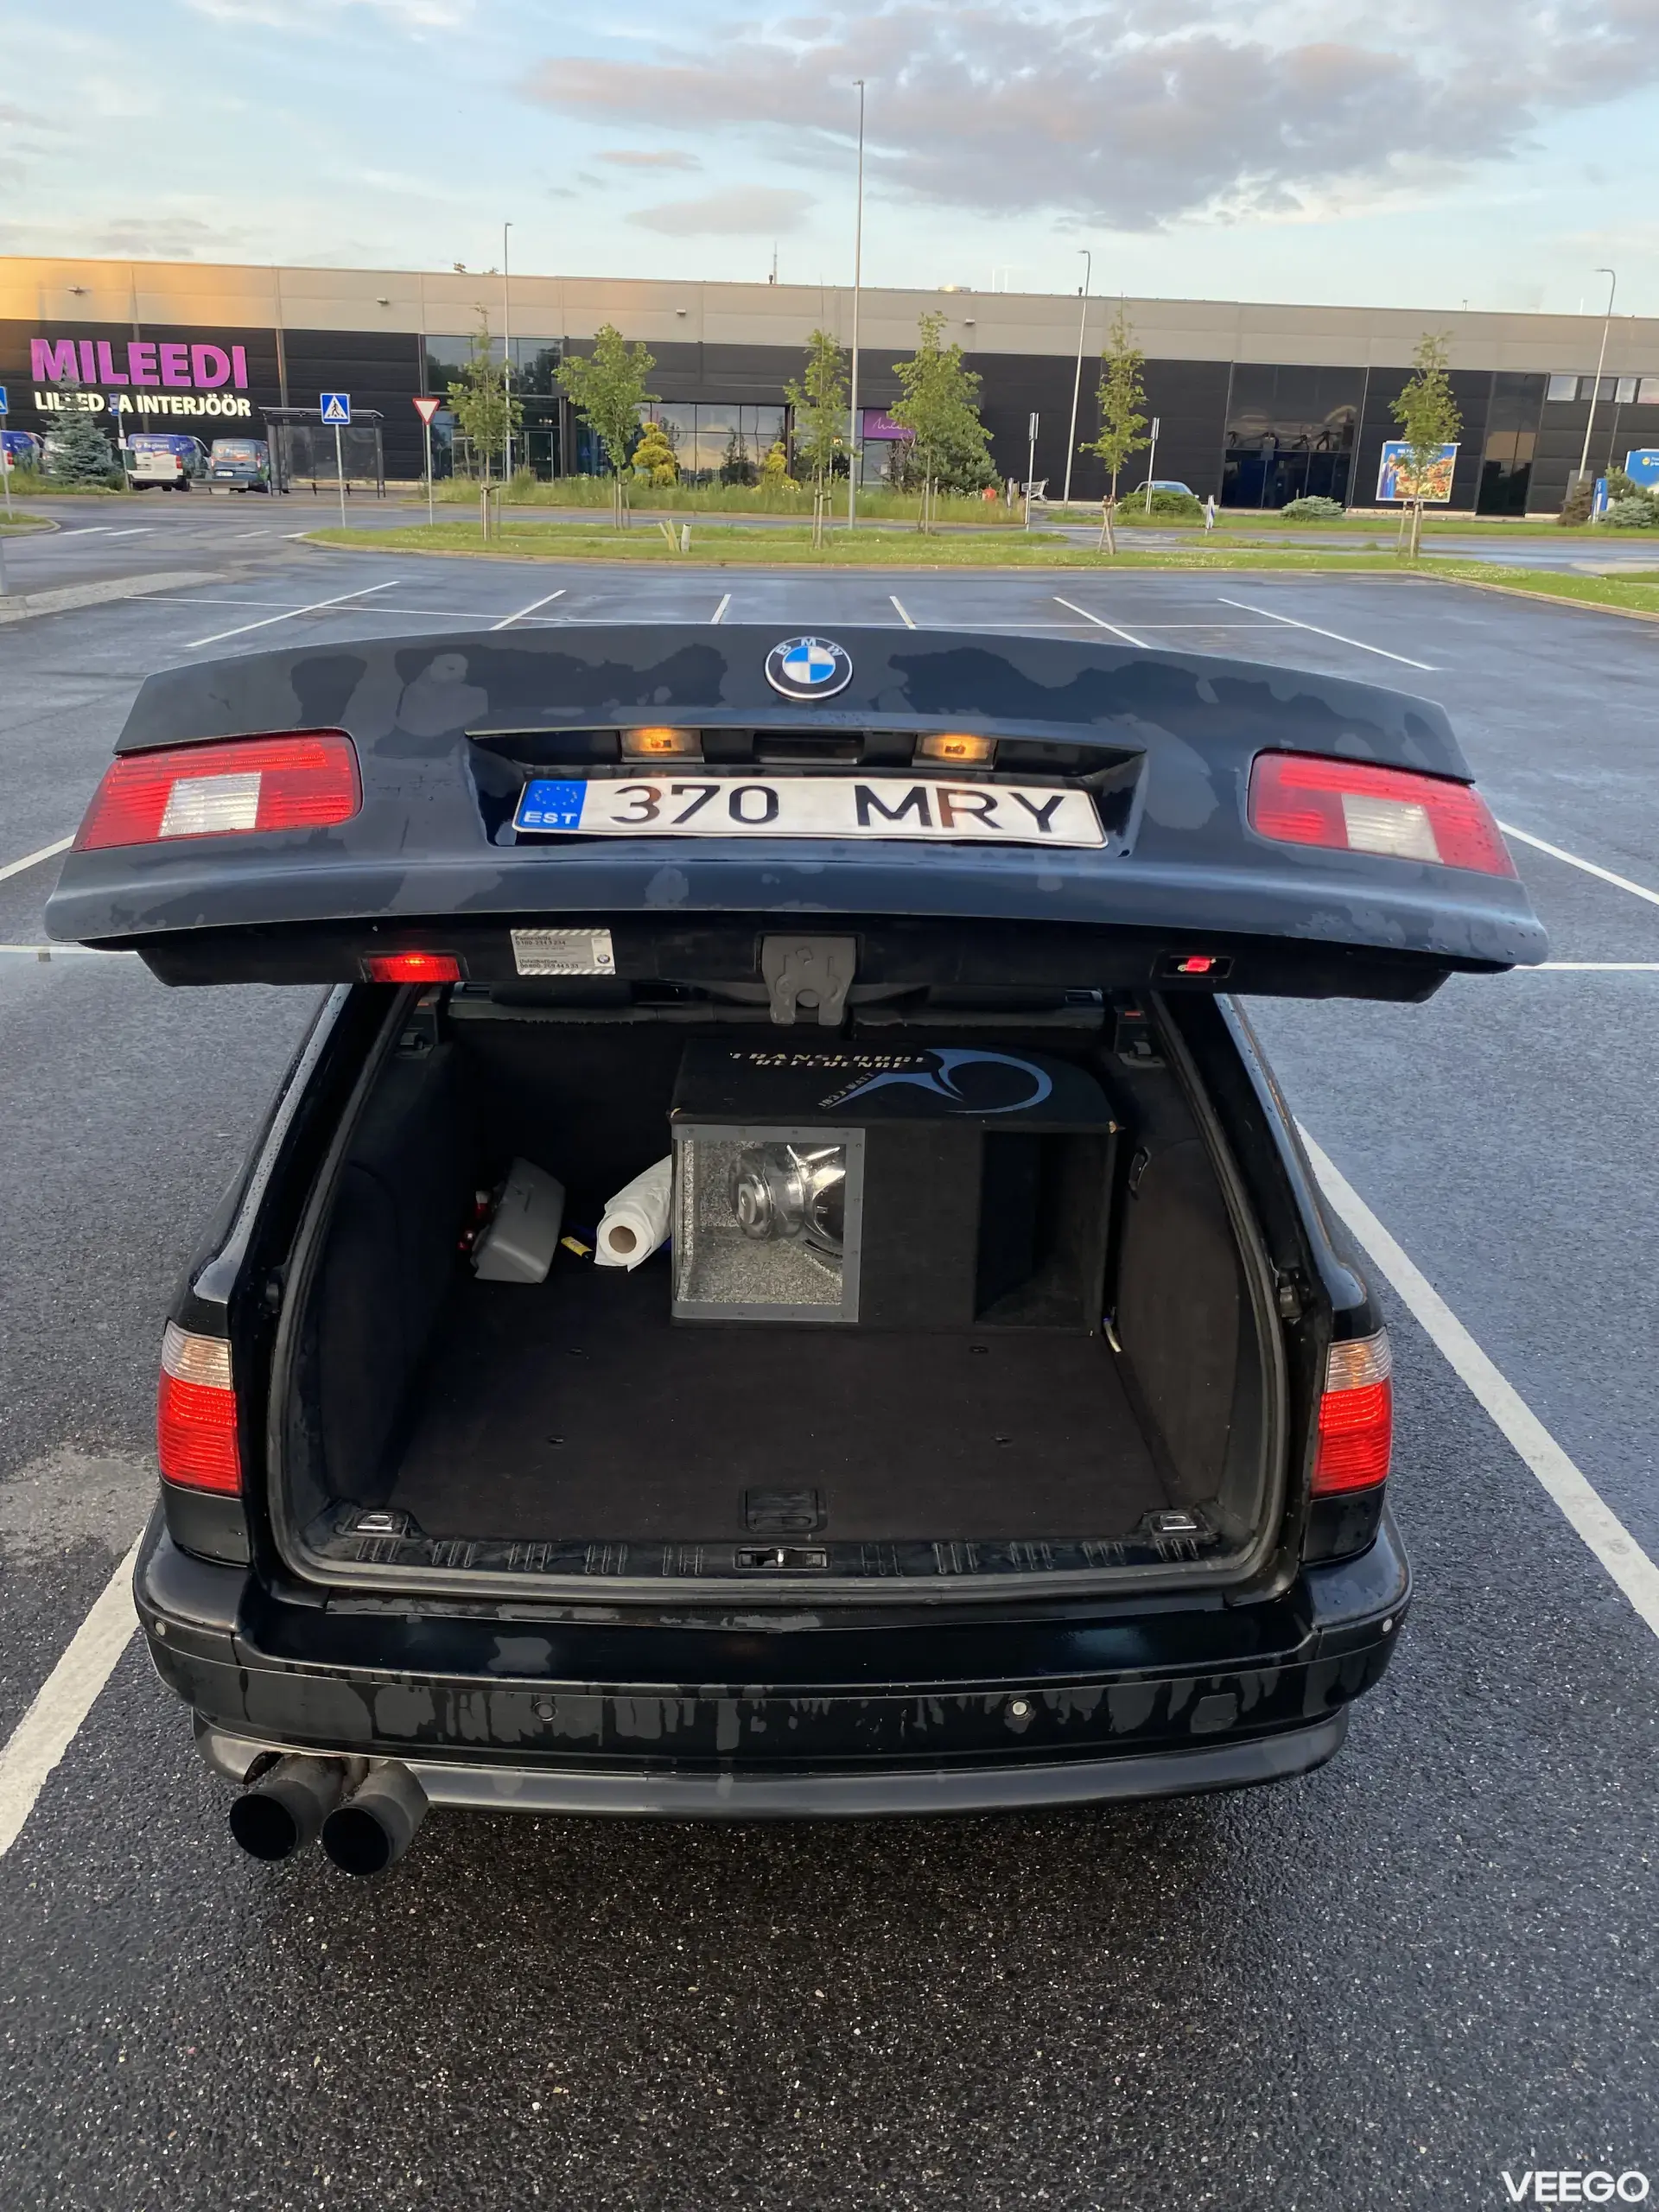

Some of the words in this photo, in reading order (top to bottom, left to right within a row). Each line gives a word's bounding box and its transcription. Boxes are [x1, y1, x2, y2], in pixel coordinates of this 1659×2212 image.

[30, 338, 249, 390] MILEEDI
[136, 393, 251, 417] INTERJÖÖR
[774, 638, 843, 657] BMW
[524, 811, 577, 824] EST
[609, 785, 779, 825] 370
[854, 785, 1066, 834] MRY
